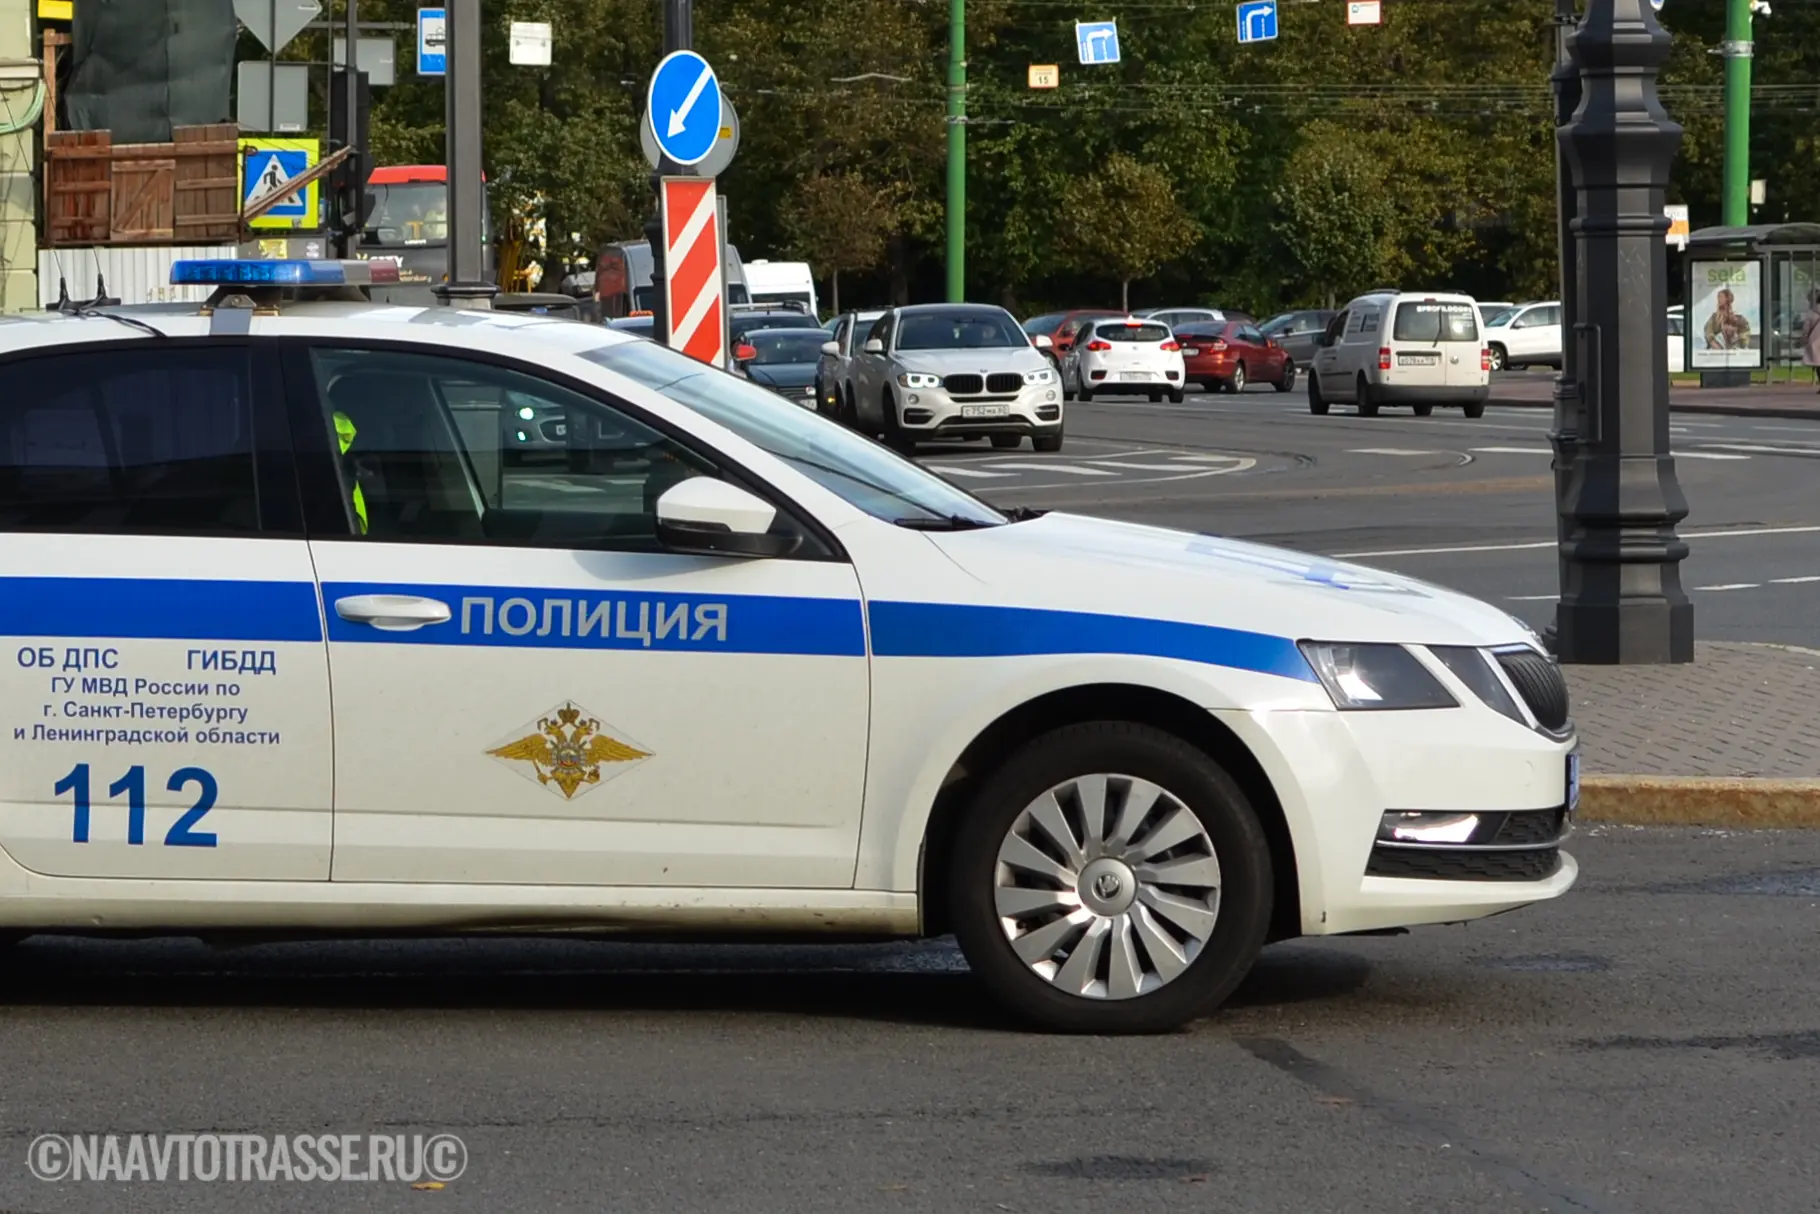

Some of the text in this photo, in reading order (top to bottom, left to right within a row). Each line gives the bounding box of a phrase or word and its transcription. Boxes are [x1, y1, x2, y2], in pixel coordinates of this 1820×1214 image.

[1708, 266, 1746, 282] sela
[460, 596, 728, 646] ПОЛИЦИЯ
[17, 648, 276, 675] ОБ ДПС ГИБДД
[51, 677, 241, 697] ГУ МВД России по
[43, 701, 248, 724] г. Санкт-Петербургу
[14, 725, 281, 745] и Ленинградской области
[53, 763, 220, 848] 112
